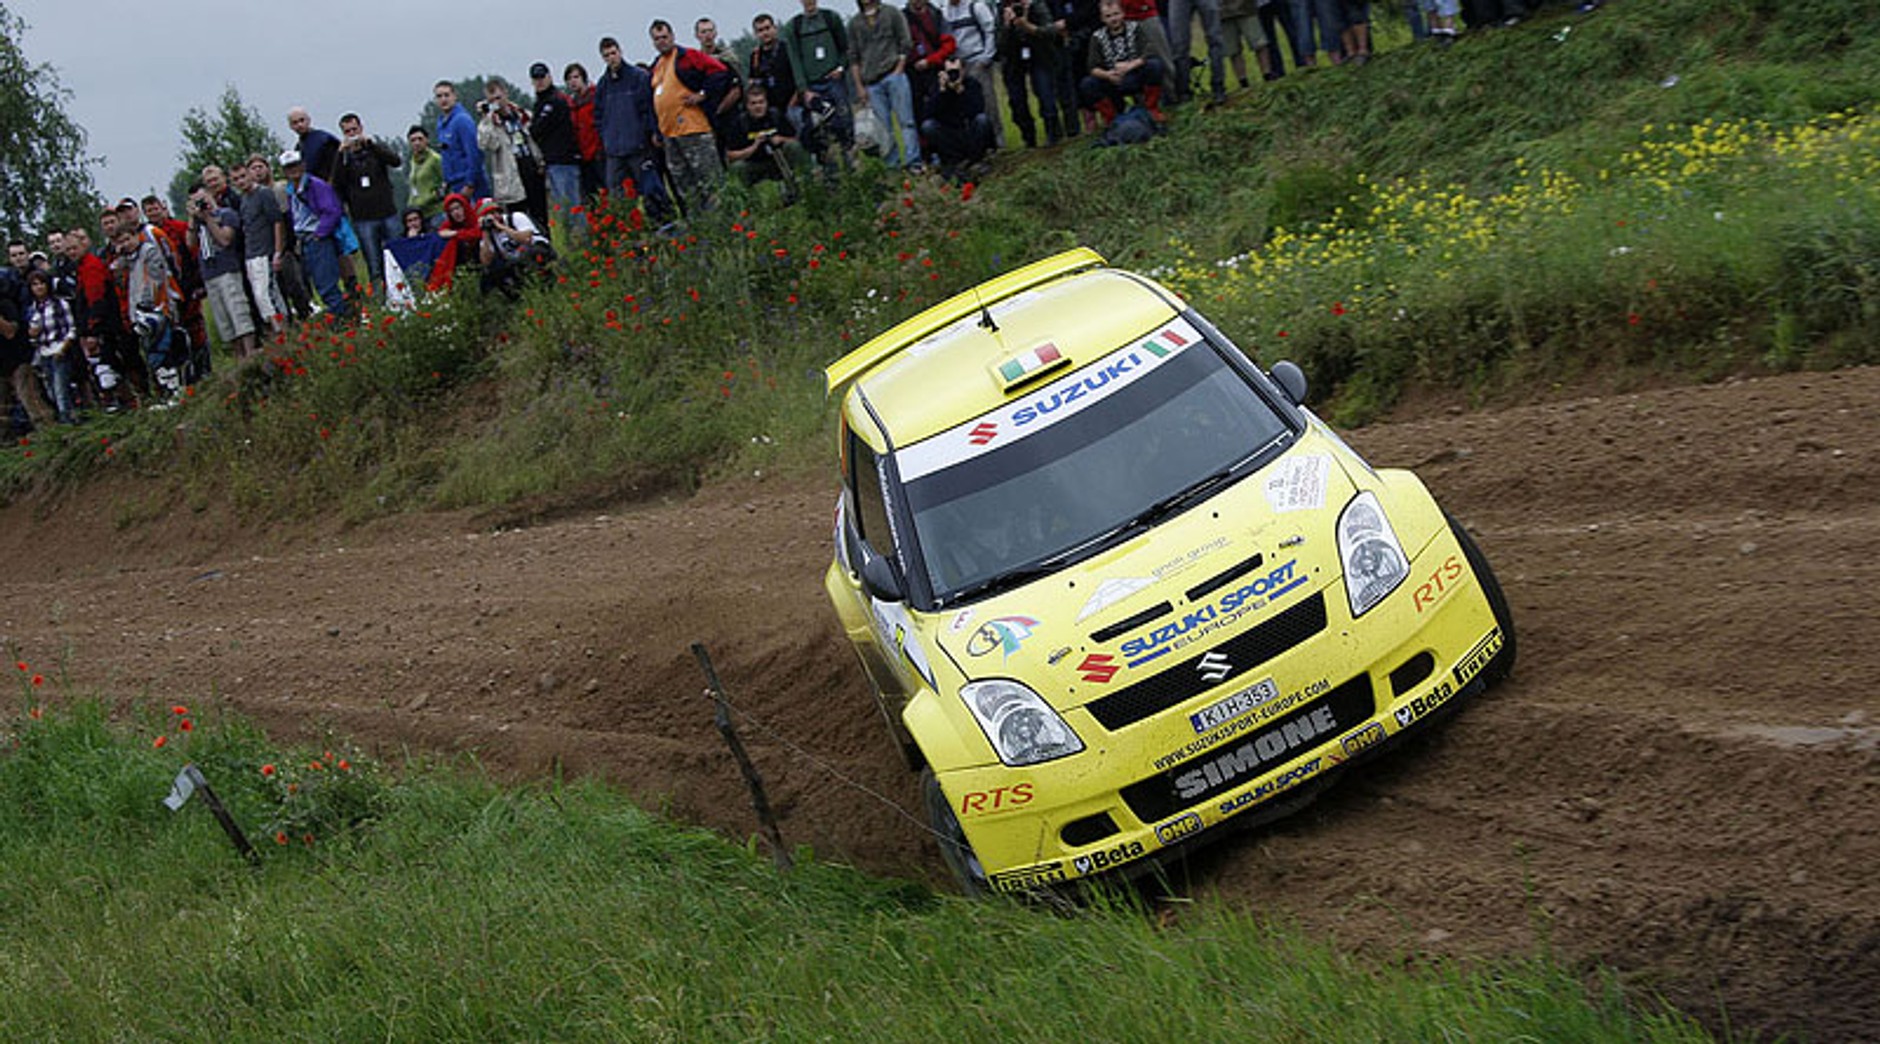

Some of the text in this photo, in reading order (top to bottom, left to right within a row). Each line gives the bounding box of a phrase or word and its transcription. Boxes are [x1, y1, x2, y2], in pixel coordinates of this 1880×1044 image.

[1010, 352, 1143, 427] SUZUKI
[1119, 558, 1297, 658] SUZUKI SPORT
[1411, 555, 1463, 613] RTS
[1173, 599, 1267, 650] EUROPE
[1153, 678, 1332, 770] WWW.SUZUKISPORT-EUROPE.COM
[1203, 683, 1273, 726] KIH-353
[1410, 682, 1453, 716] Beta
[1174, 704, 1338, 799] SIMONE
[960, 782, 1034, 815] RTS
[1220, 757, 1322, 814] SUZUKI SPORT
[1093, 839, 1146, 868] Beta
[1161, 816, 1200, 843] OMP
